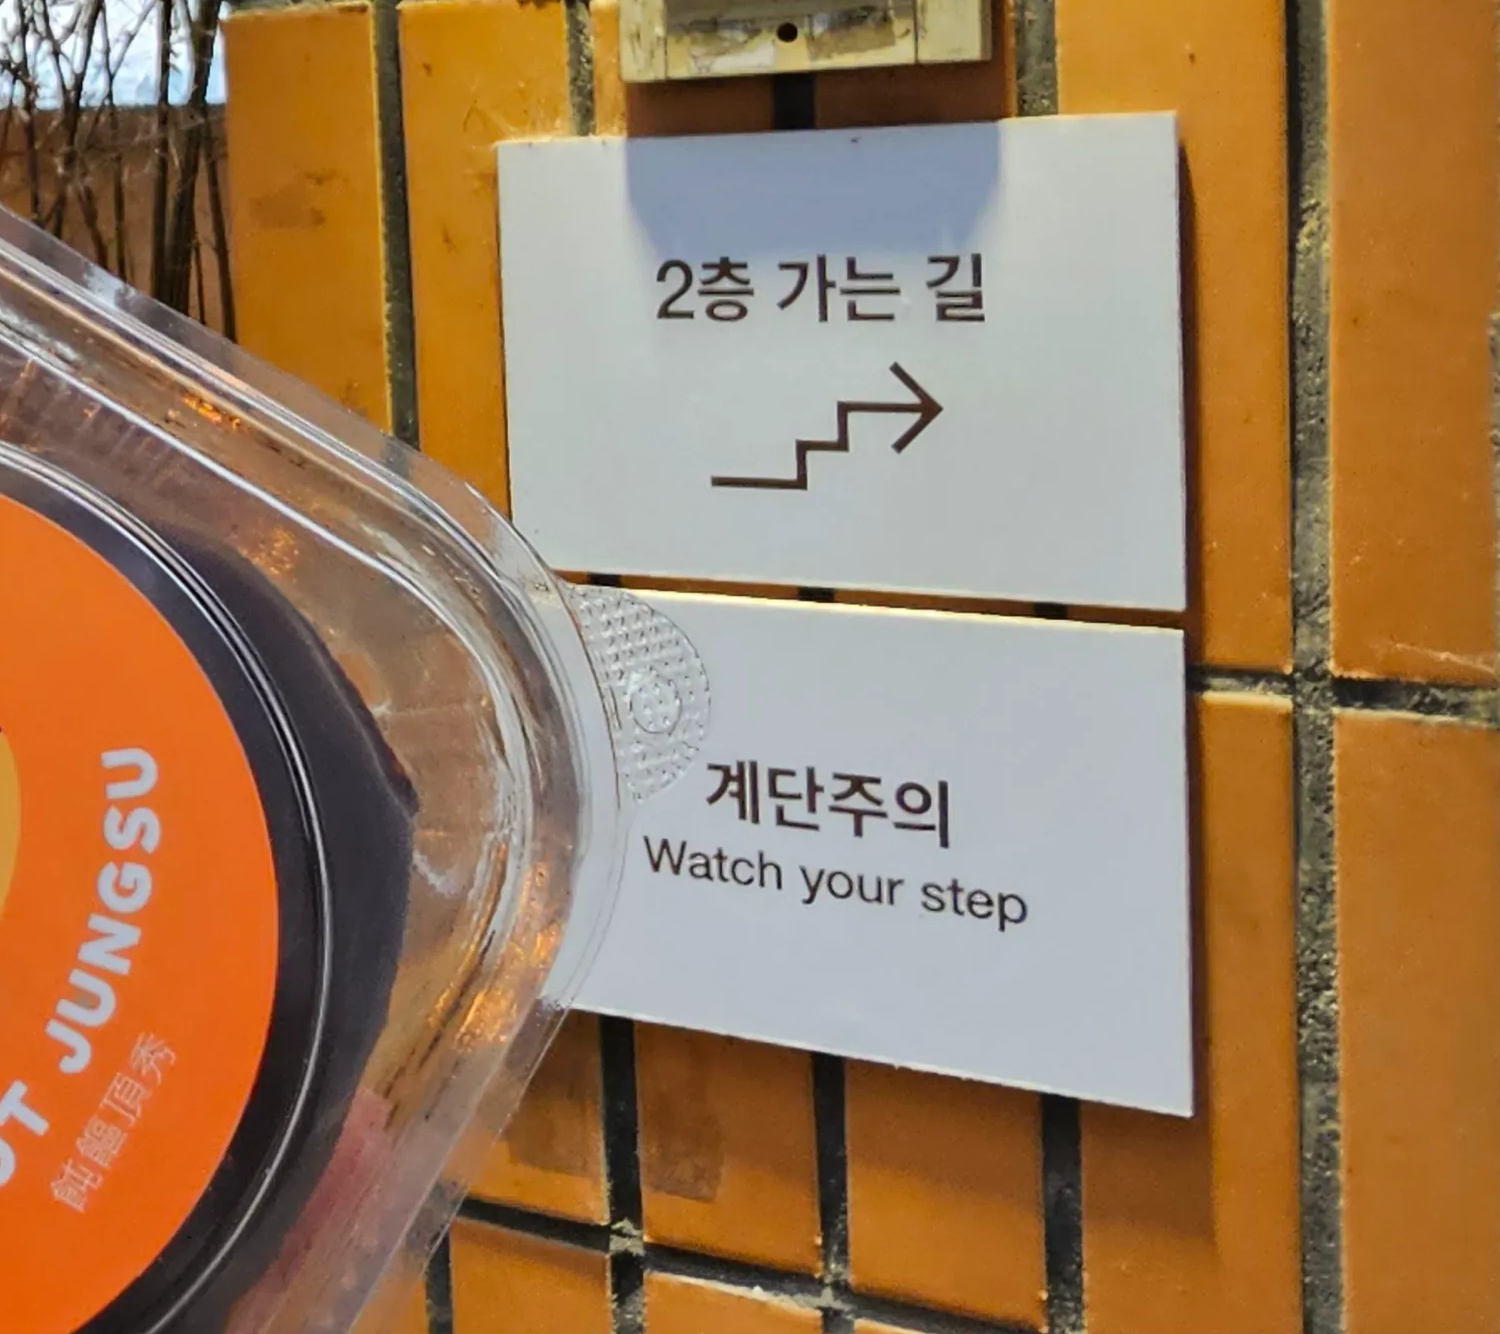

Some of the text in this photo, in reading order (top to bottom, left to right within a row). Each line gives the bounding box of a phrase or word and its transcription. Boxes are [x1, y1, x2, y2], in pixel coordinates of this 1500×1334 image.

[655, 252, 986, 323] 2층 가는 길
[705, 759, 950, 849] 계단주의
[44, 747, 161, 1075] JUNGSU
[643, 835, 1029, 933] Watch your step
